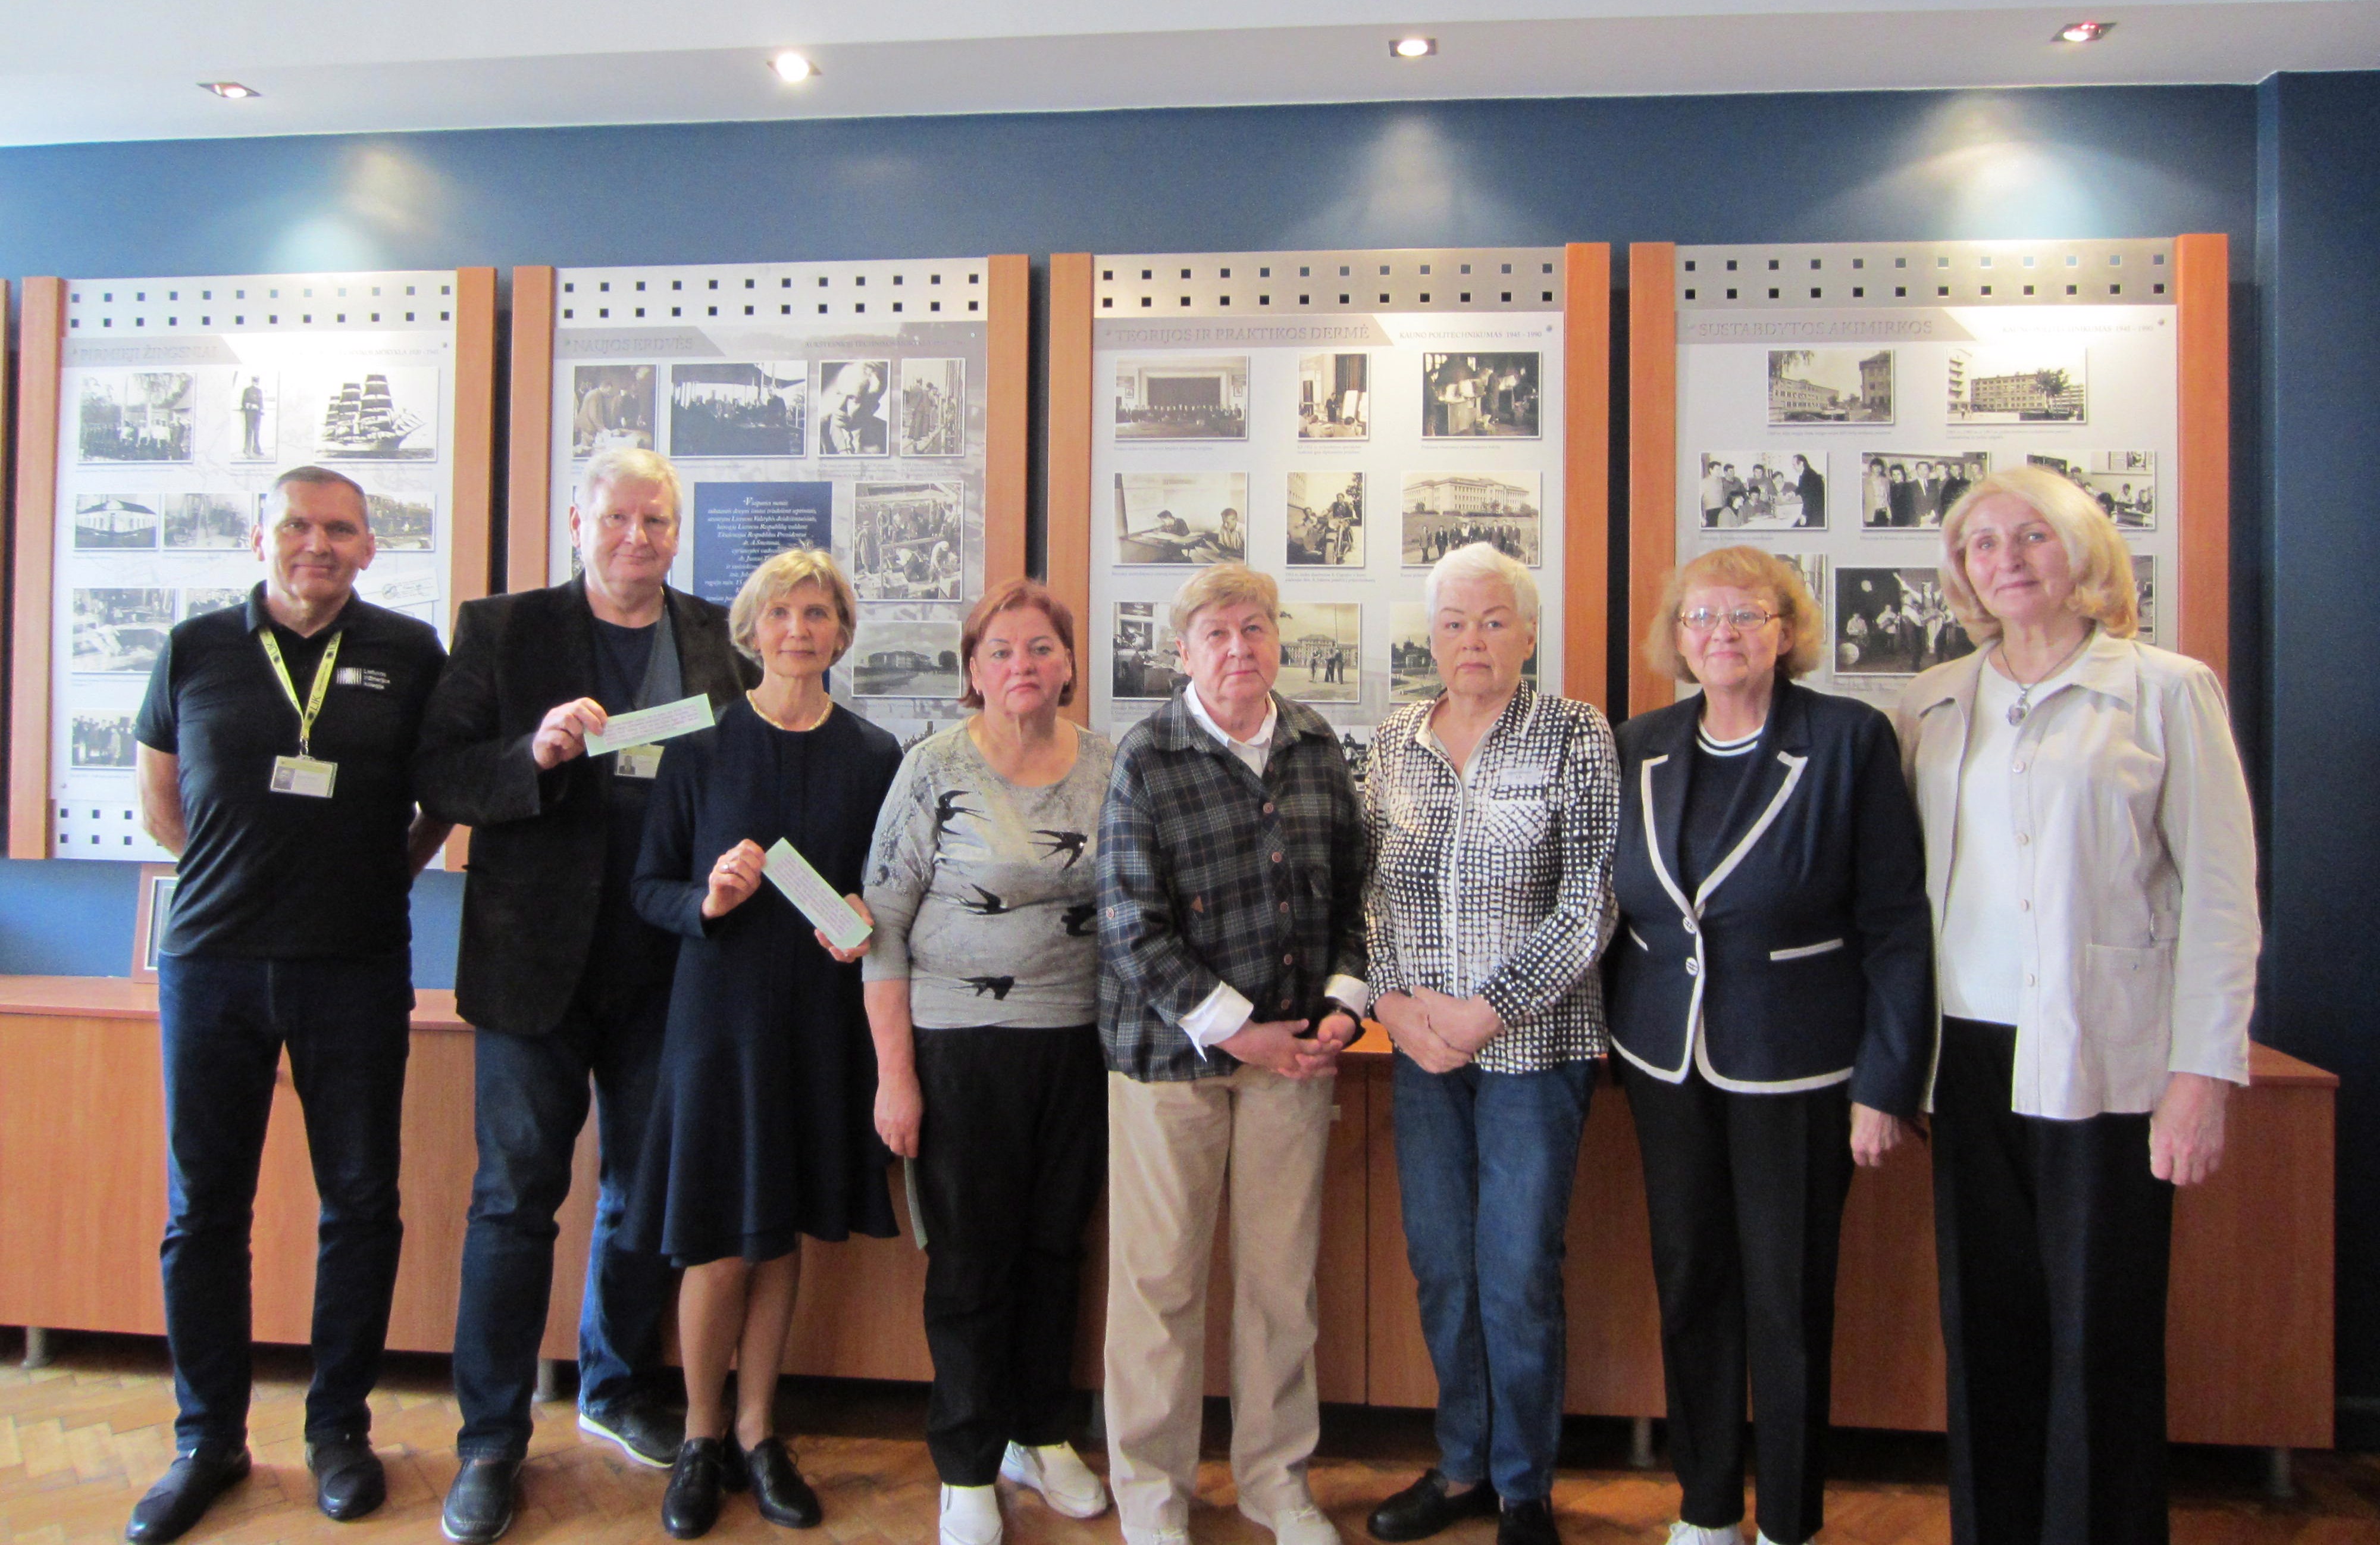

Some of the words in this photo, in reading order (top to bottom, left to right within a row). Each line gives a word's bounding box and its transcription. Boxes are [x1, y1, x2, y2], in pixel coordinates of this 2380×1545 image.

[1116, 329, 1191, 343] TEORIJOS
[1195, 329, 1211, 340] IR
[1216, 327, 1307, 340] PRAKTIKOS
[1310, 324, 1370, 339] DERMĖ
[1698, 321, 1825, 336] SUSTABDYTOS
[1828, 320, 1933, 334] AKIMIRKOS
[573, 339, 630, 354] NAUJOS
[633, 335, 694, 351] ERDVĖS
[312, 695, 322, 711] LIK
